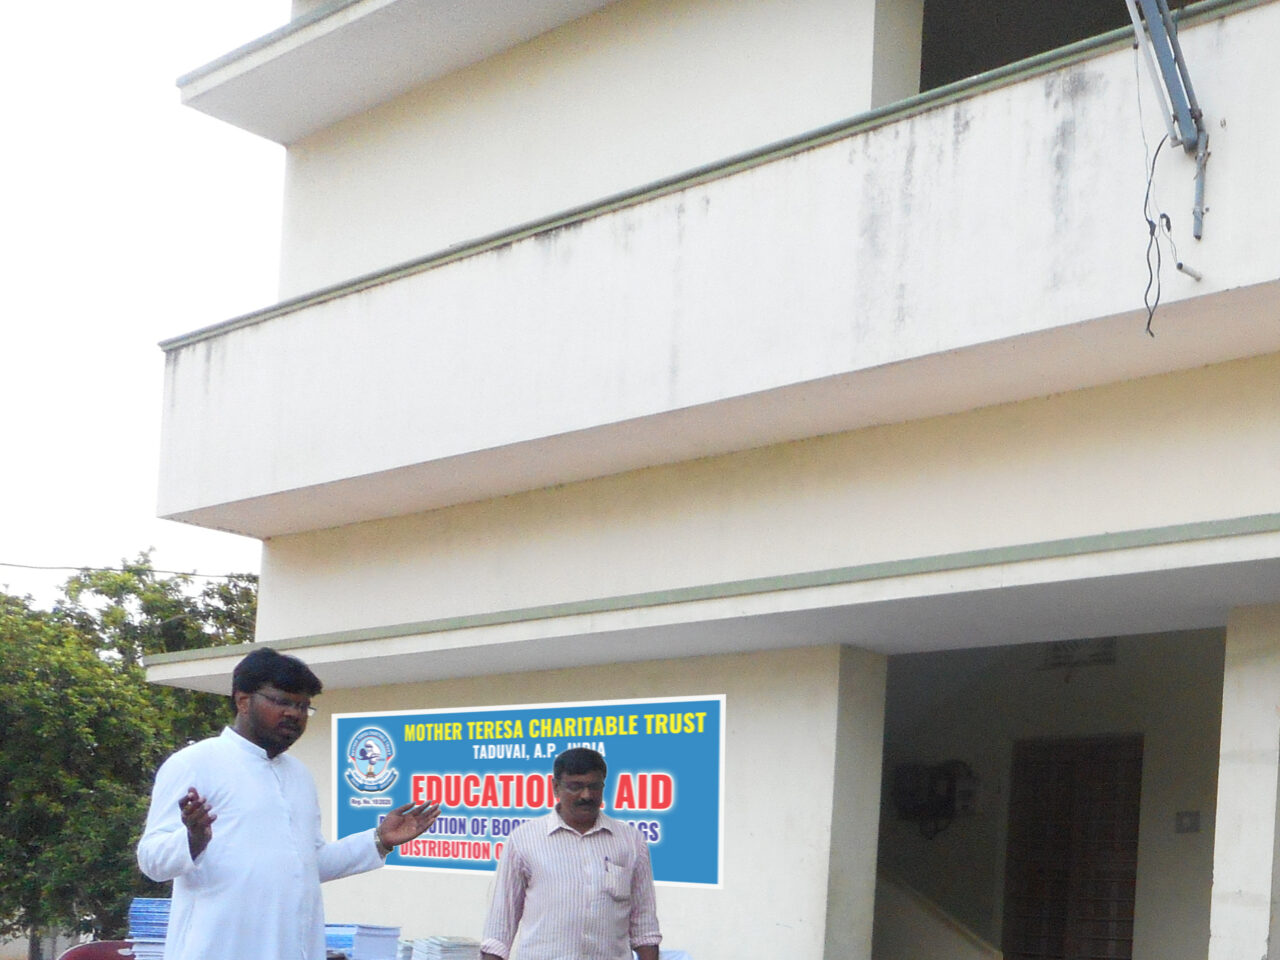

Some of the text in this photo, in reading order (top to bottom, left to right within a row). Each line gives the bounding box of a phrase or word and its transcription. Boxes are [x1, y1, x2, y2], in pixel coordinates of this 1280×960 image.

[404, 712, 707, 742] MOTHER TERESA CHARITABLE TRUST
[472, 744, 530, 760] TADUVAI,
[412, 774, 605, 808] EDUCATIO
[614, 774, 673, 810] AID
[471, 817, 488, 836] OF
[400, 840, 491, 860] DISTRIBUTION
